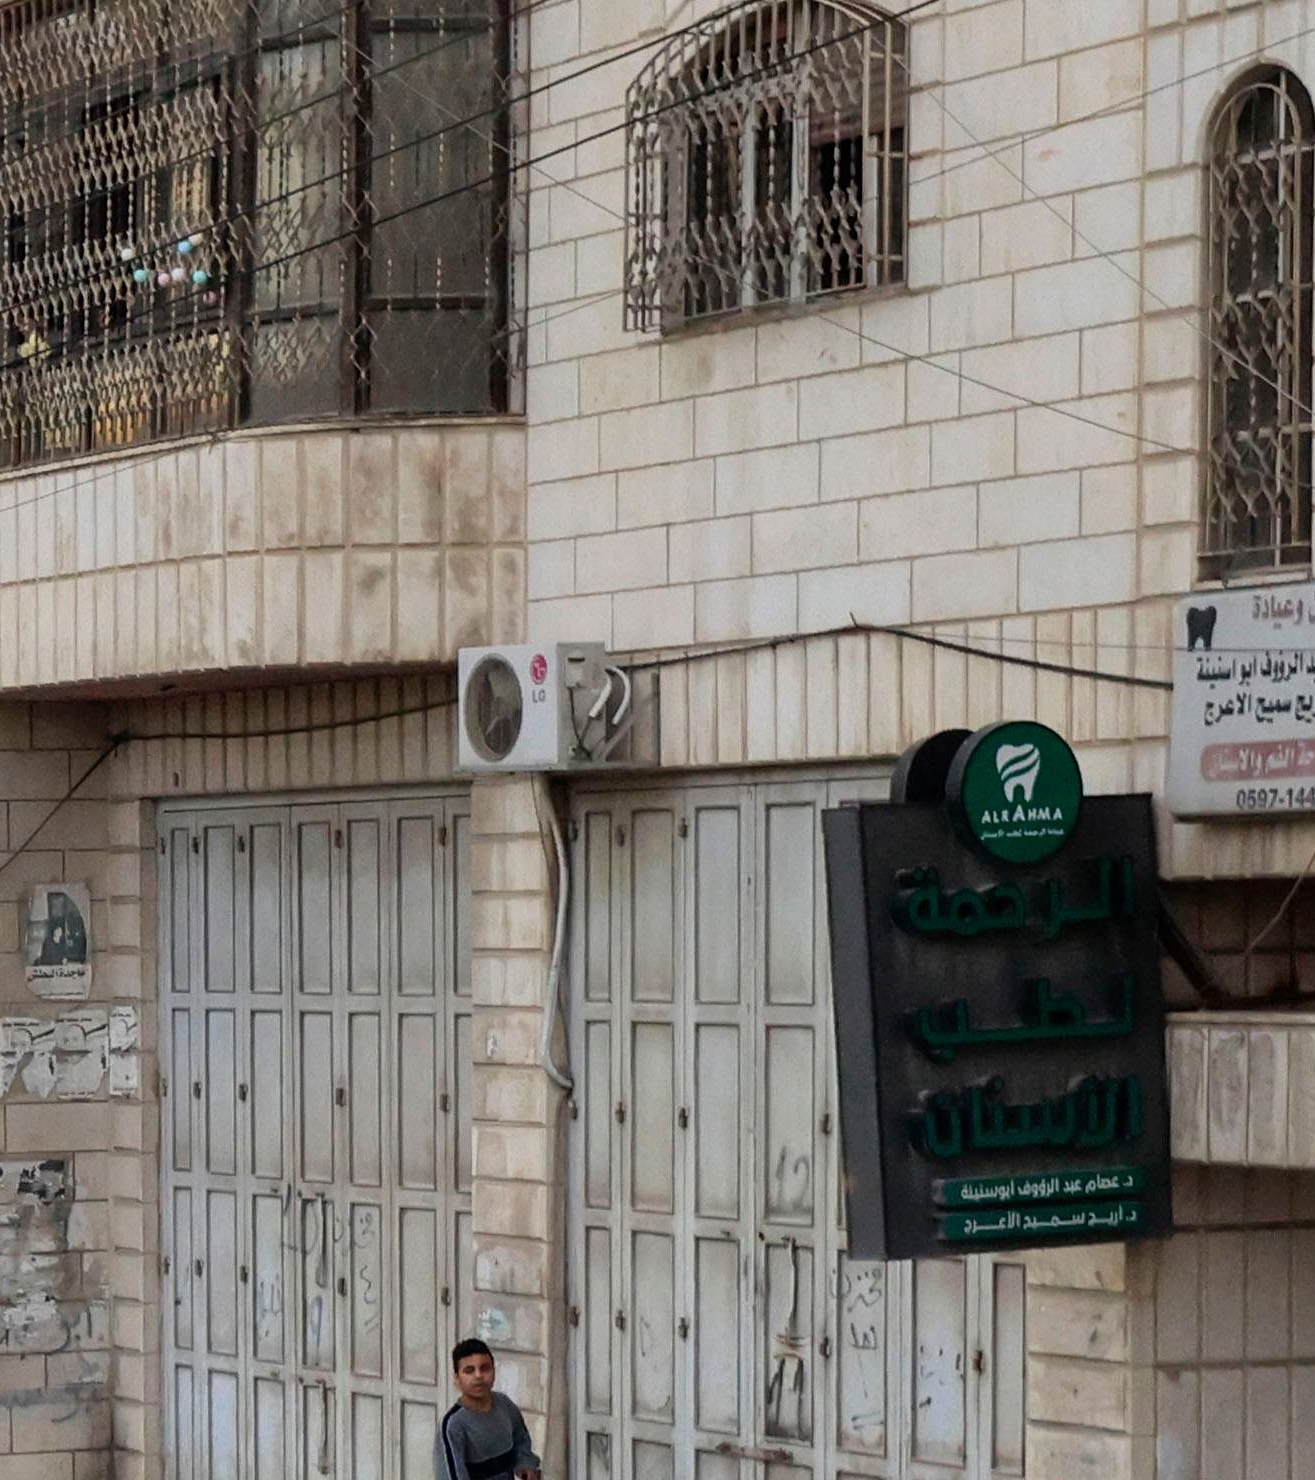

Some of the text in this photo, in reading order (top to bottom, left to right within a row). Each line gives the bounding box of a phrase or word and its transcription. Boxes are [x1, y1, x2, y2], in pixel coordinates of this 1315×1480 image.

[532, 689, 546, 703] LG
[900, 856, 1136, 939] الرحمة
[919, 970, 1136, 1062] لطب
[1063, 1179, 1082, 1194] عبد
